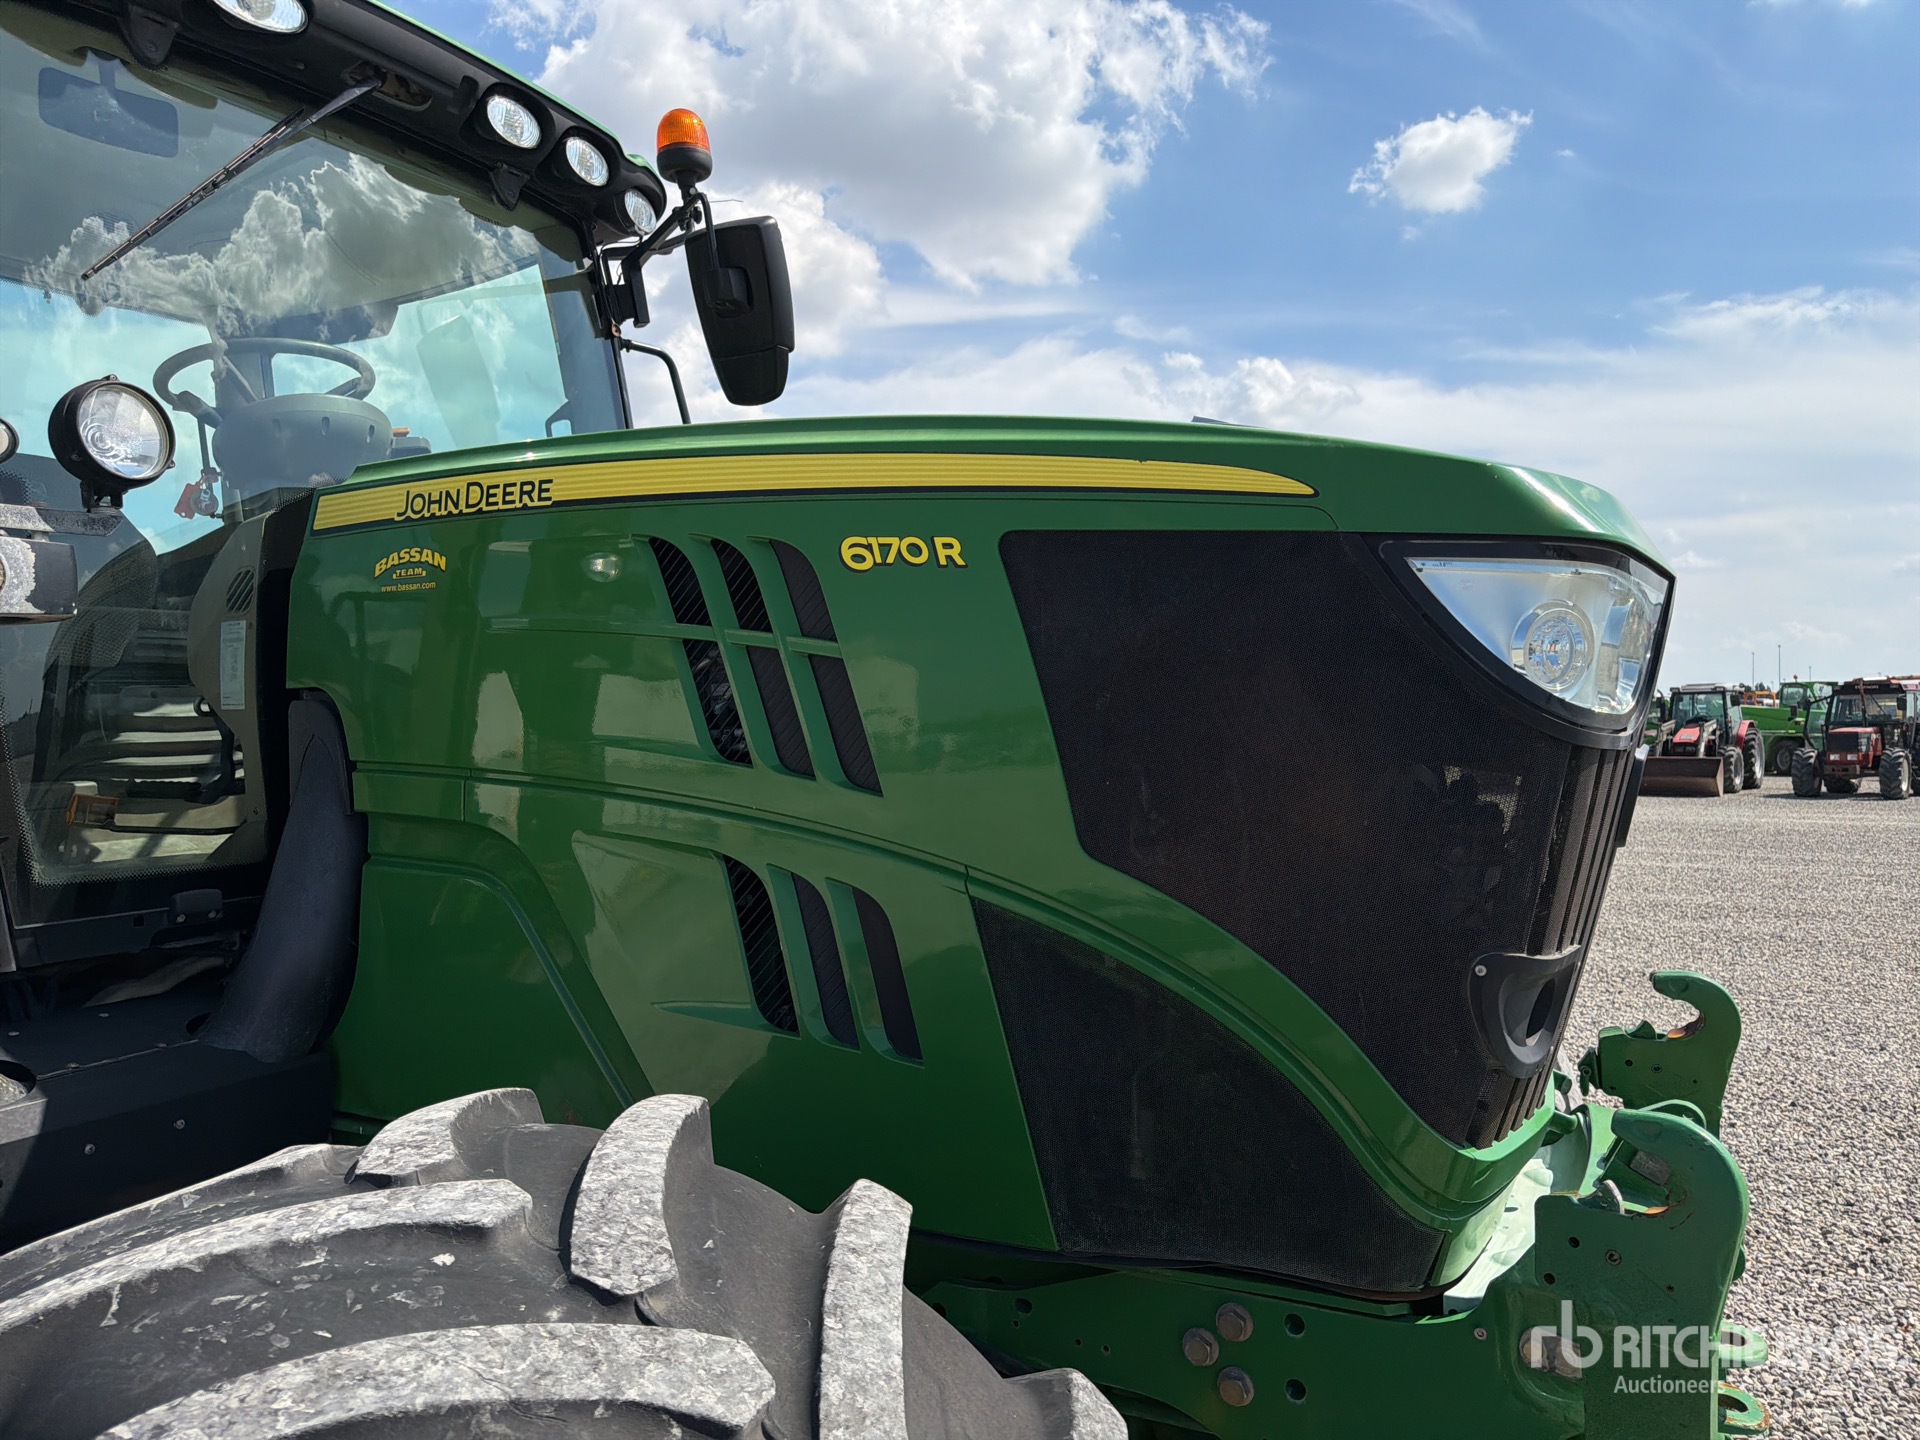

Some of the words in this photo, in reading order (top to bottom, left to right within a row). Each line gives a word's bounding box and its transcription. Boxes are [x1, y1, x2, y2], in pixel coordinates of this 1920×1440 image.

[395, 489, 461, 520] JOHN
[463, 478, 555, 511] DEERE
[374, 547, 447, 578] BASSAN
[839, 535, 929, 573] 6170
[381, 581, 437, 593] www.bassan.com
[395, 567, 423, 577] TEAM
